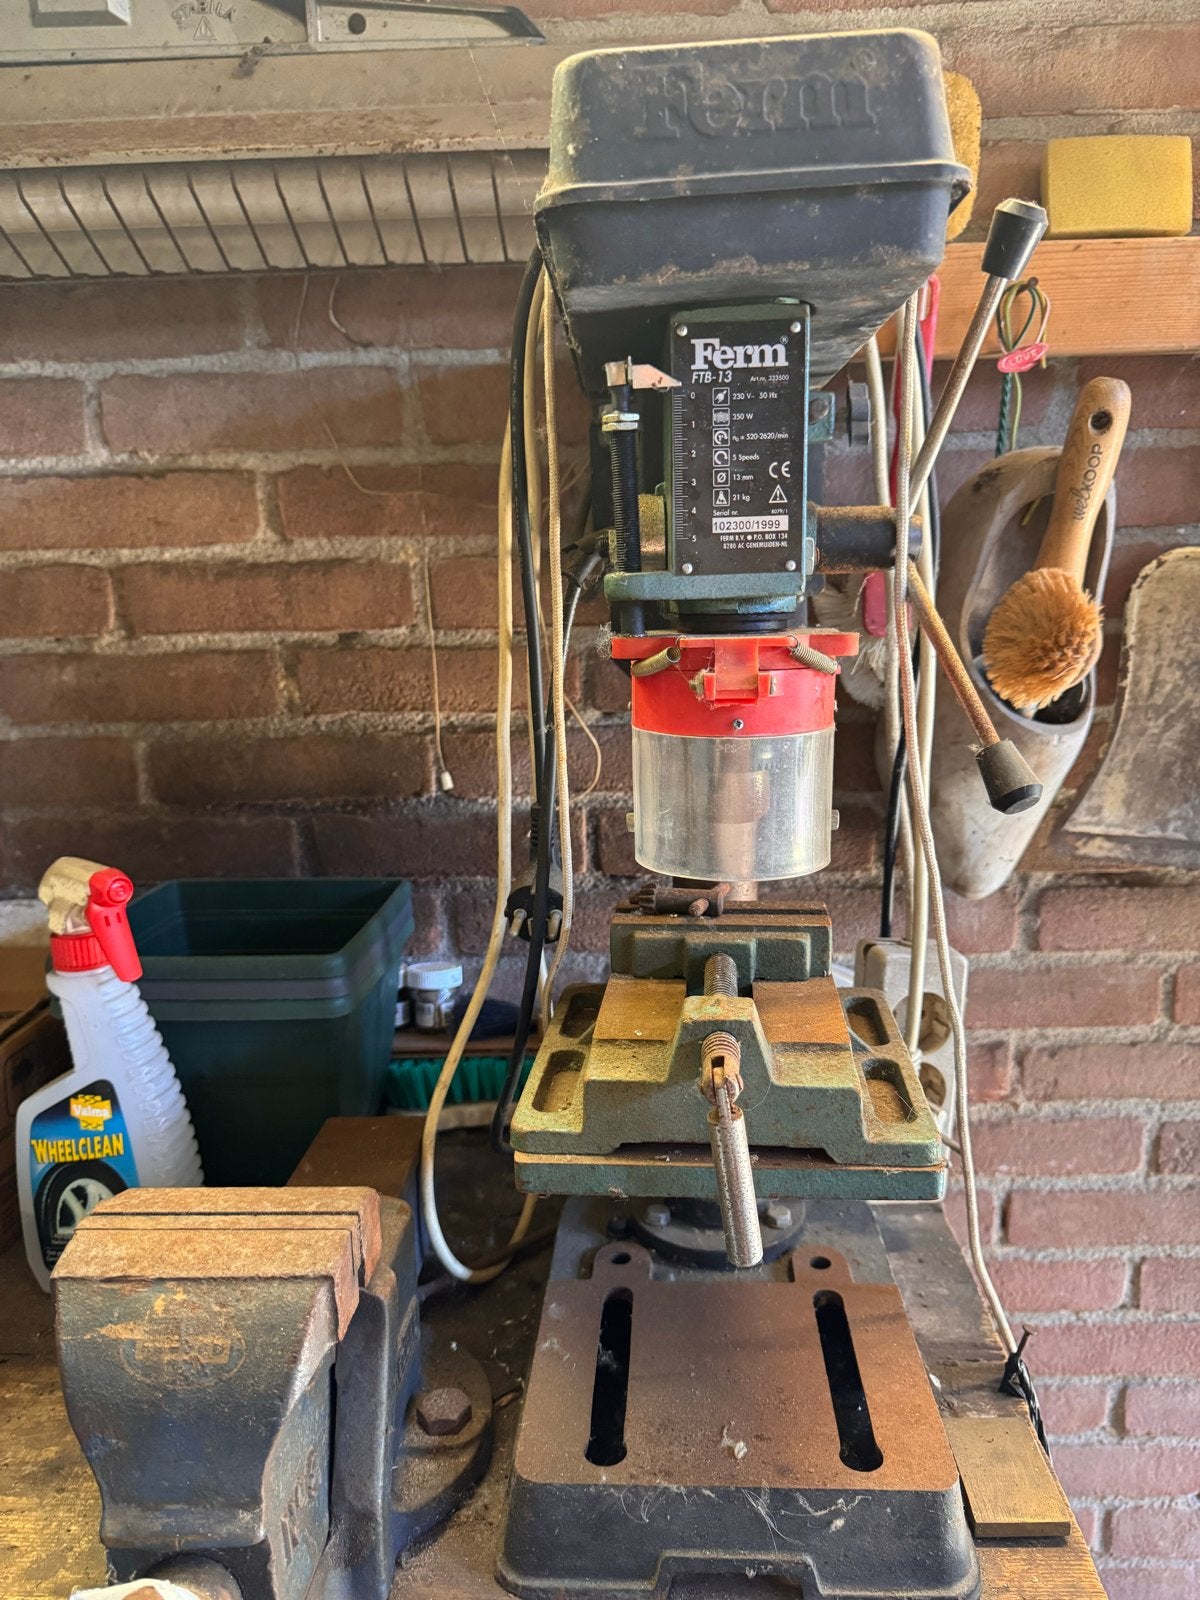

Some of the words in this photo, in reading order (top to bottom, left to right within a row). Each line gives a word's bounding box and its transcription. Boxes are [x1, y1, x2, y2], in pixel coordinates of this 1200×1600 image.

[171, 0, 236, 25] STABILA
[691, 371, 732, 384] FTB-13
[759, 391, 768, 399] 50
[769, 391, 778, 399] Hz
[746, 412, 754, 420] W
[691, 450, 697, 458] 2
[738, 452, 760, 461] Speeds
[768, 461, 791, 479] CE
[742, 493, 751, 502] kg
[712, 509, 730, 517] Serial
[713, 519, 781, 531] 102300/1999
[31, 1132, 125, 1164] WHEELCLEAN
